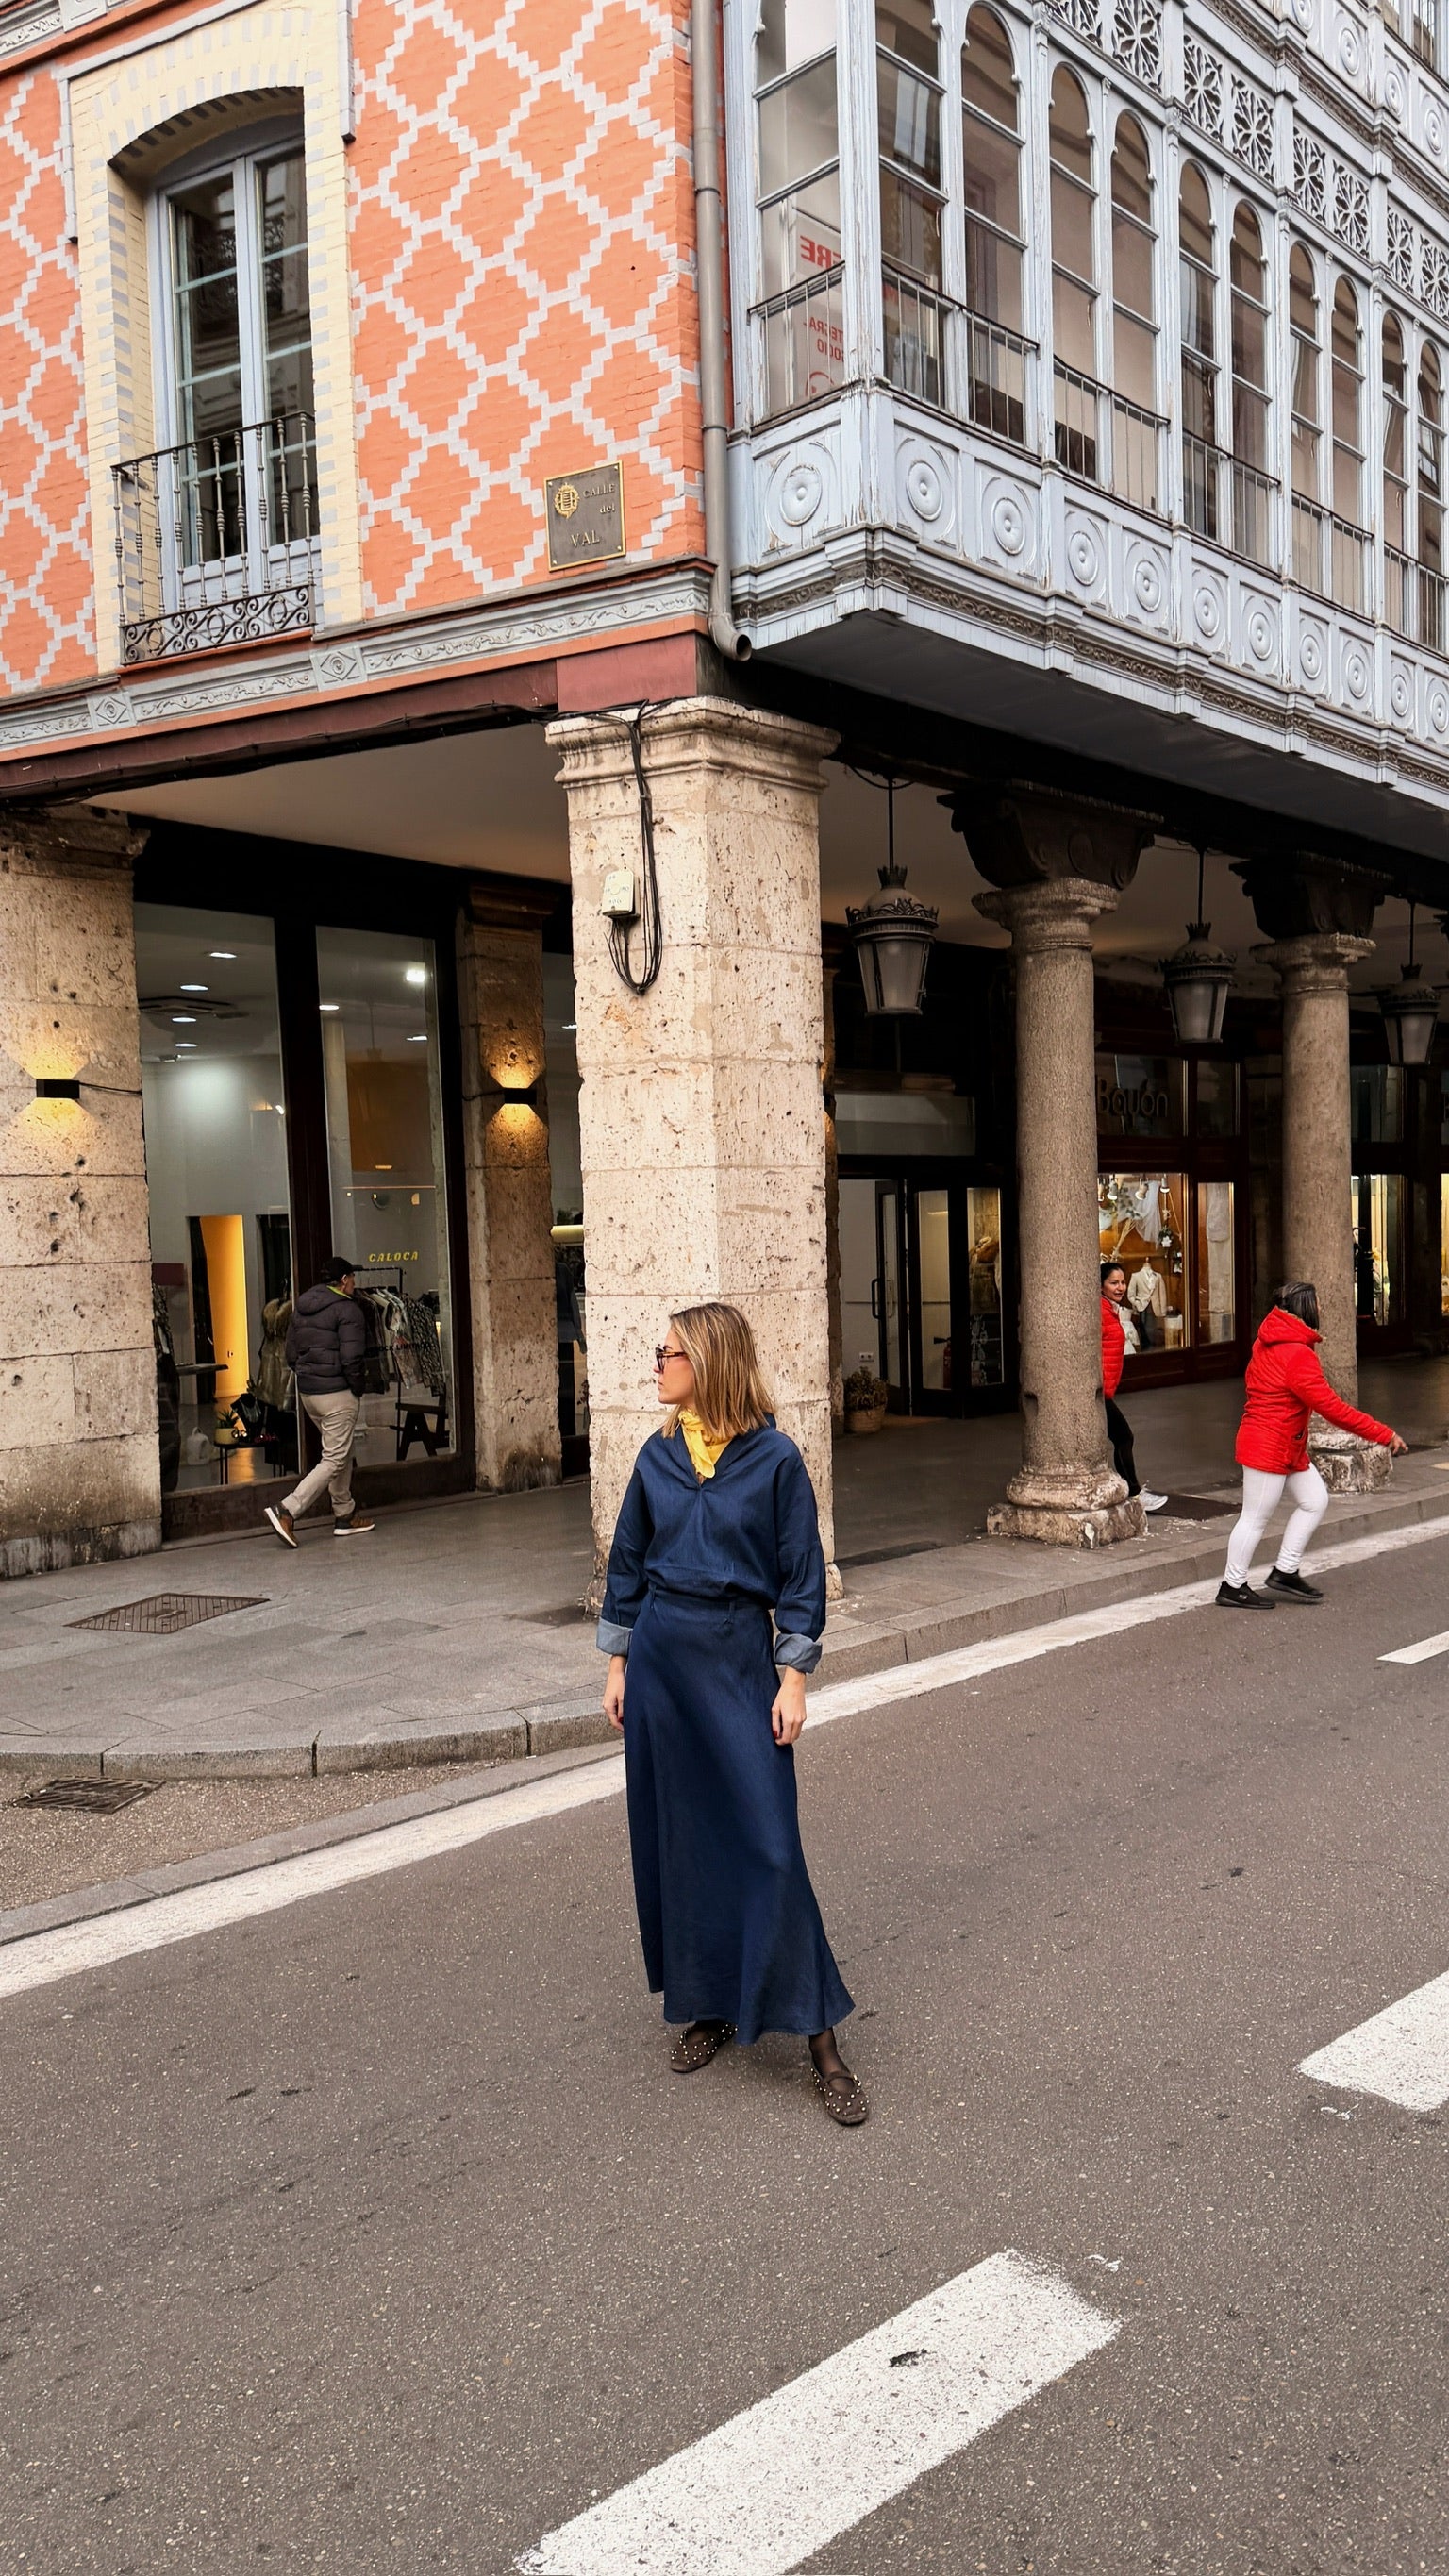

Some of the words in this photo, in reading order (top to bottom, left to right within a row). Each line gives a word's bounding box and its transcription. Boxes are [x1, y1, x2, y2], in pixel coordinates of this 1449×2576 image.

[583, 483, 615, 499] CALLE
[599, 502, 615, 513] del
[570, 529, 601, 547] VAL
[368, 1251, 419, 1263] CALOCA
